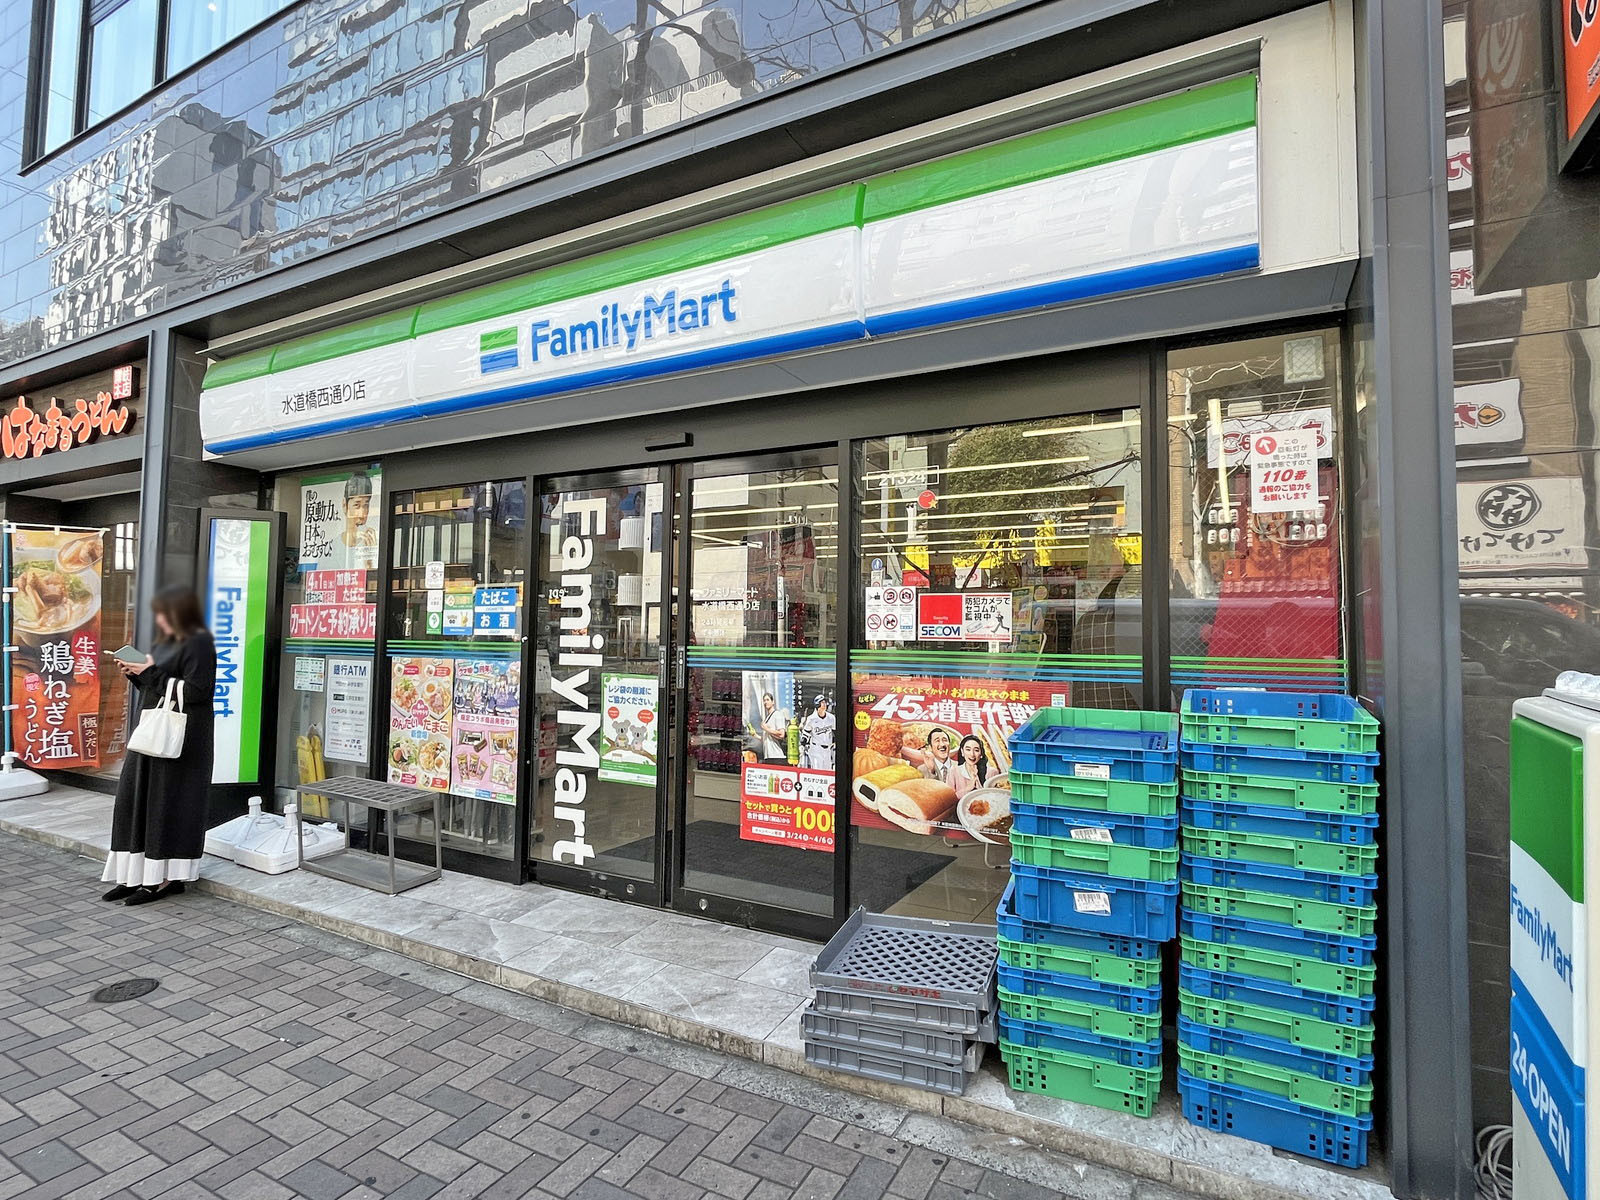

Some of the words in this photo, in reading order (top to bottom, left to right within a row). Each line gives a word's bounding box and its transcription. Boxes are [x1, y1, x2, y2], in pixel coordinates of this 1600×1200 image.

[531, 278, 737, 362] FamilyMart
[281, 379, 367, 415] 水道橋西通り店
[2, 392, 129, 459] はなまるうどん
[879, 470, 926, 487] 21324
[1263, 468, 1308, 483] 110番
[1258, 483, 1312, 493] 通報のご協力を
[1263, 492, 1308, 501] お願いします
[304, 523, 326, 541] 日本の
[481, 591, 511, 605] たばこ
[965, 597, 1011, 606] 防犯カメラで
[965, 604, 998, 613] セコムが
[921, 625, 961, 636] SECOM
[74, 636, 97, 677] 生姜
[550, 497, 607, 866] FamilyMart
[38, 641, 79, 759] 鶏ねぎ塩
[607, 695, 654, 707] ご協力ください。
[950, 687, 1031, 701] お値段そのまま
[24, 698, 42, 764] うどん
[82, 716, 98, 758] 極みだし
[745, 801, 793, 815] セットで買うと
[793, 806, 835, 834] 100
[1510, 884, 1574, 993] FamilyMart
